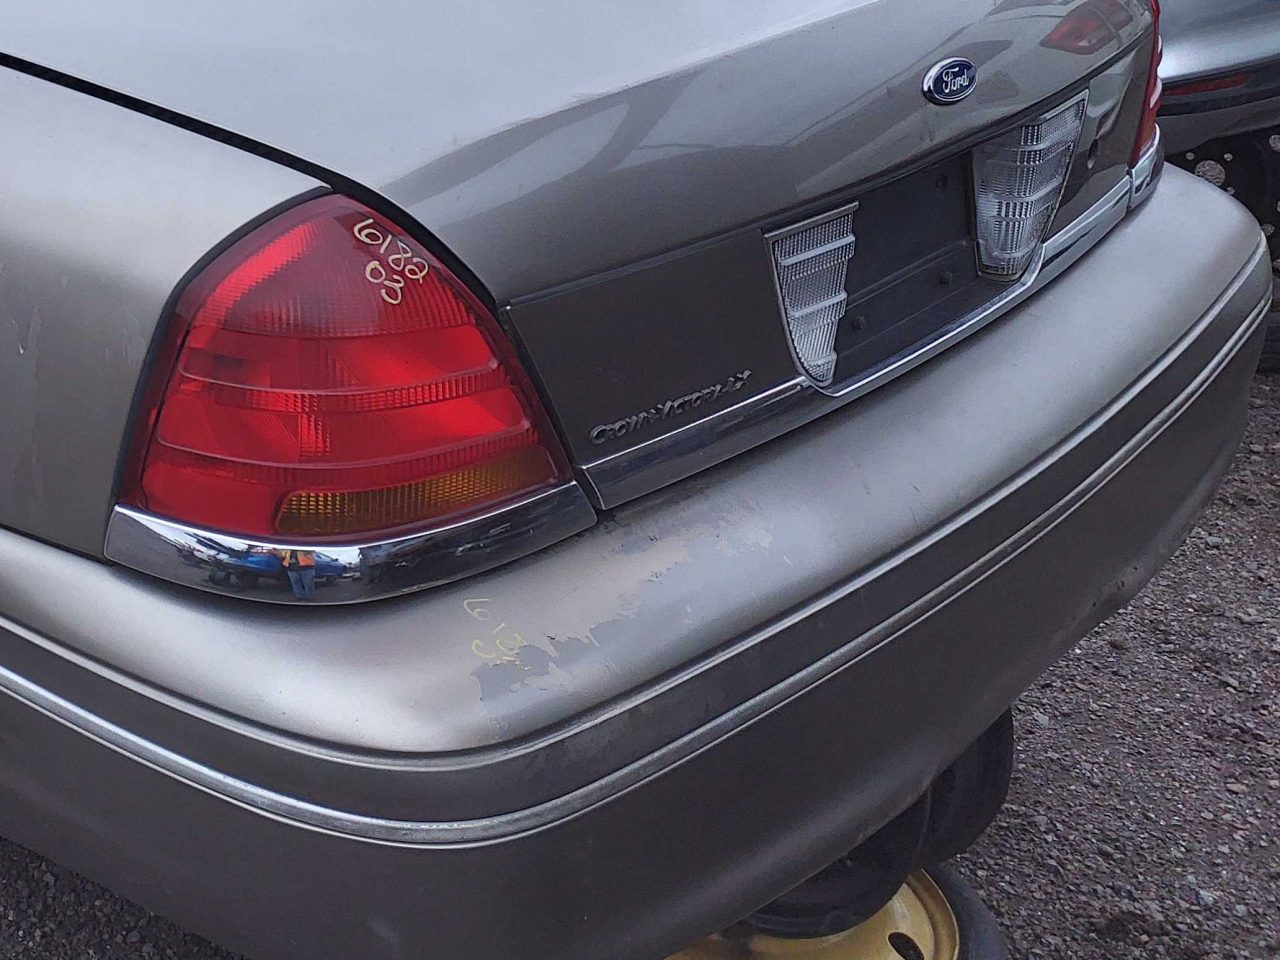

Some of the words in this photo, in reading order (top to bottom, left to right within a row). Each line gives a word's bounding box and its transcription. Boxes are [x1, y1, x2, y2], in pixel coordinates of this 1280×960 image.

[942, 66, 970, 94] Ford
[353, 218, 429, 285] 6182
[365, 260, 405, 305] 03
